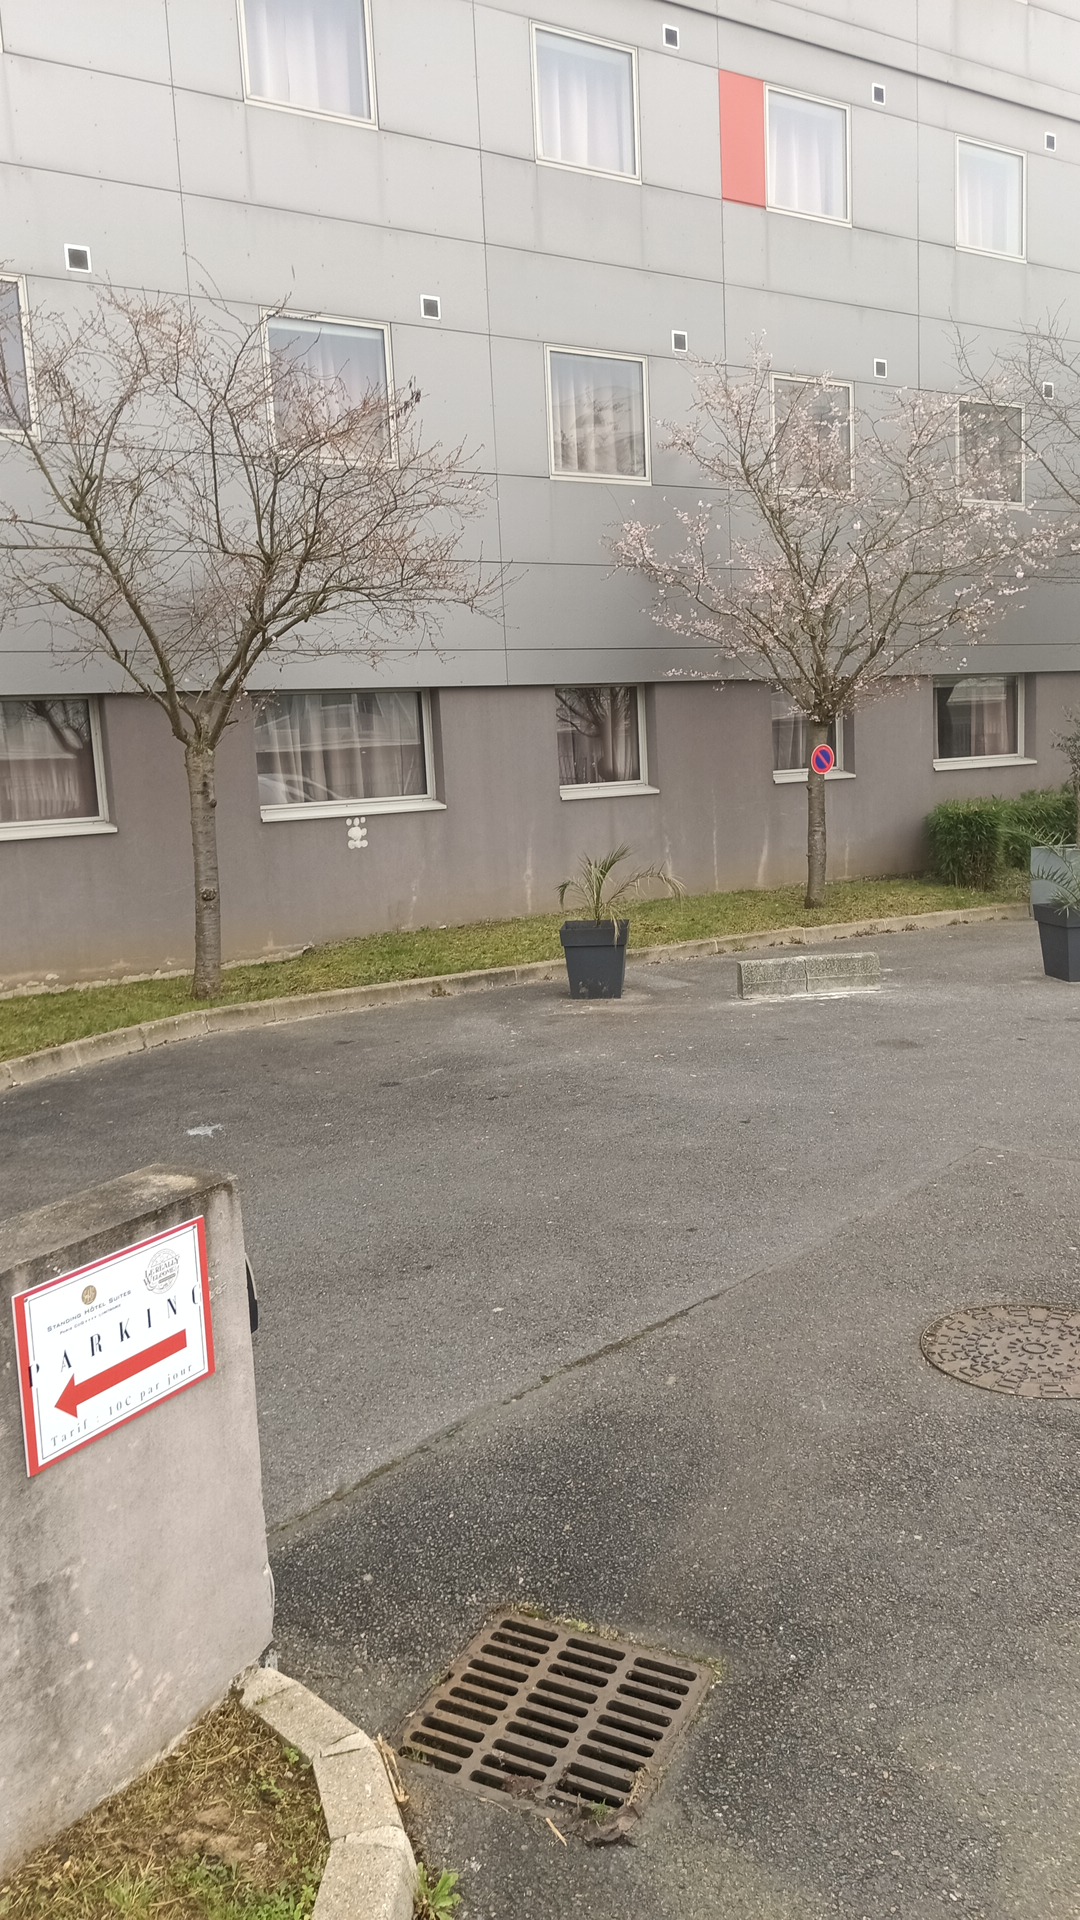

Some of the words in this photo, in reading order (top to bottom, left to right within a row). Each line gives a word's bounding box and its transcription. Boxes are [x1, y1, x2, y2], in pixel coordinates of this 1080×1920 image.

[50, 1417, 88, 1447] Tarif
[140, 1381, 161, 1401] par
[167, 1364, 193, 1385] jour
